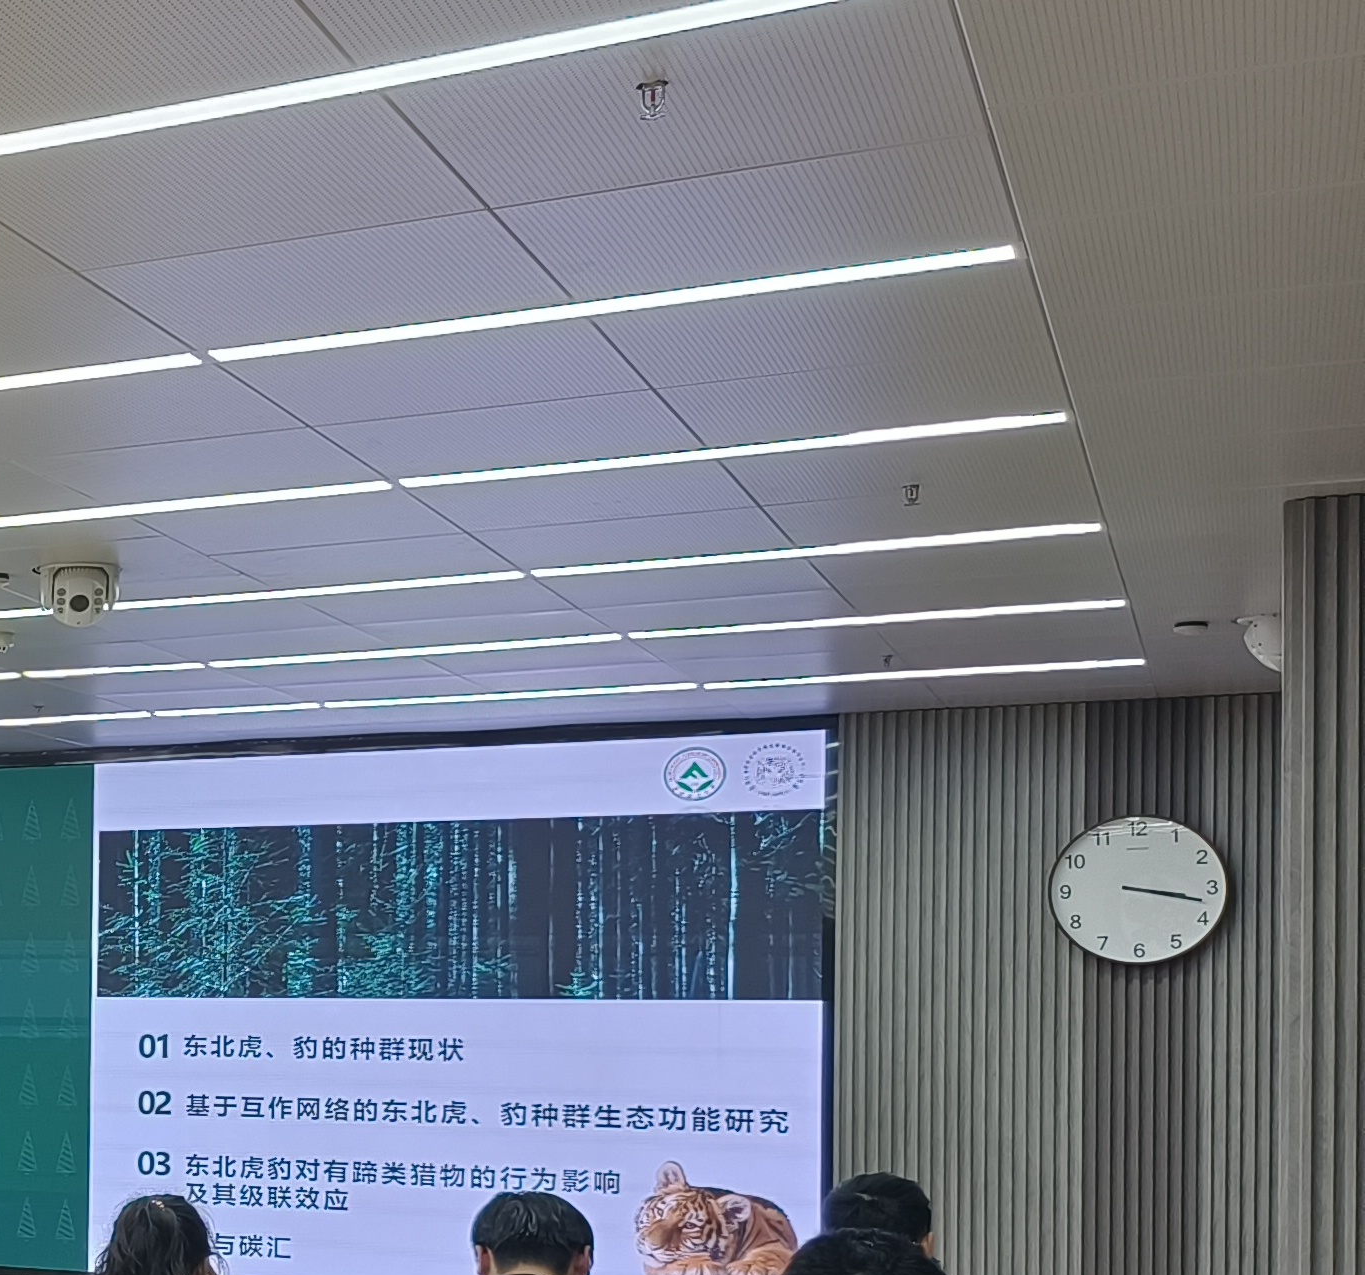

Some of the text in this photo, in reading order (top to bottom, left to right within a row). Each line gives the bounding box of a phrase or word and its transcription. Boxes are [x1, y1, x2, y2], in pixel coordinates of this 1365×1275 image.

[1127, 821, 1148, 836] 12
[1171, 828, 1179, 843] 1
[1092, 832, 1110, 846] 11
[1065, 854, 1086, 869] 10
[1196, 850, 1208, 864] 2
[1060, 885, 1072, 900] 9
[1206, 880, 1218, 895] 3
[1070, 915, 1082, 929] 8
[1197, 911, 1209, 926] 4
[1097, 936, 1109, 950] 7
[1170, 934, 1182, 949] 5
[1134, 943, 1146, 958] 6
[138, 1033, 464, 1062] 01 东北虎、豹的种群现状
[138, 1090, 790, 1134] 02 基于互作网络的东北虎、豹种群生态功能研究
[138, 1151, 620, 1194] 03 东北虎豹对有蹄类猎物的行为影响
[186, 1183, 349, 1211] 及其级联效应
